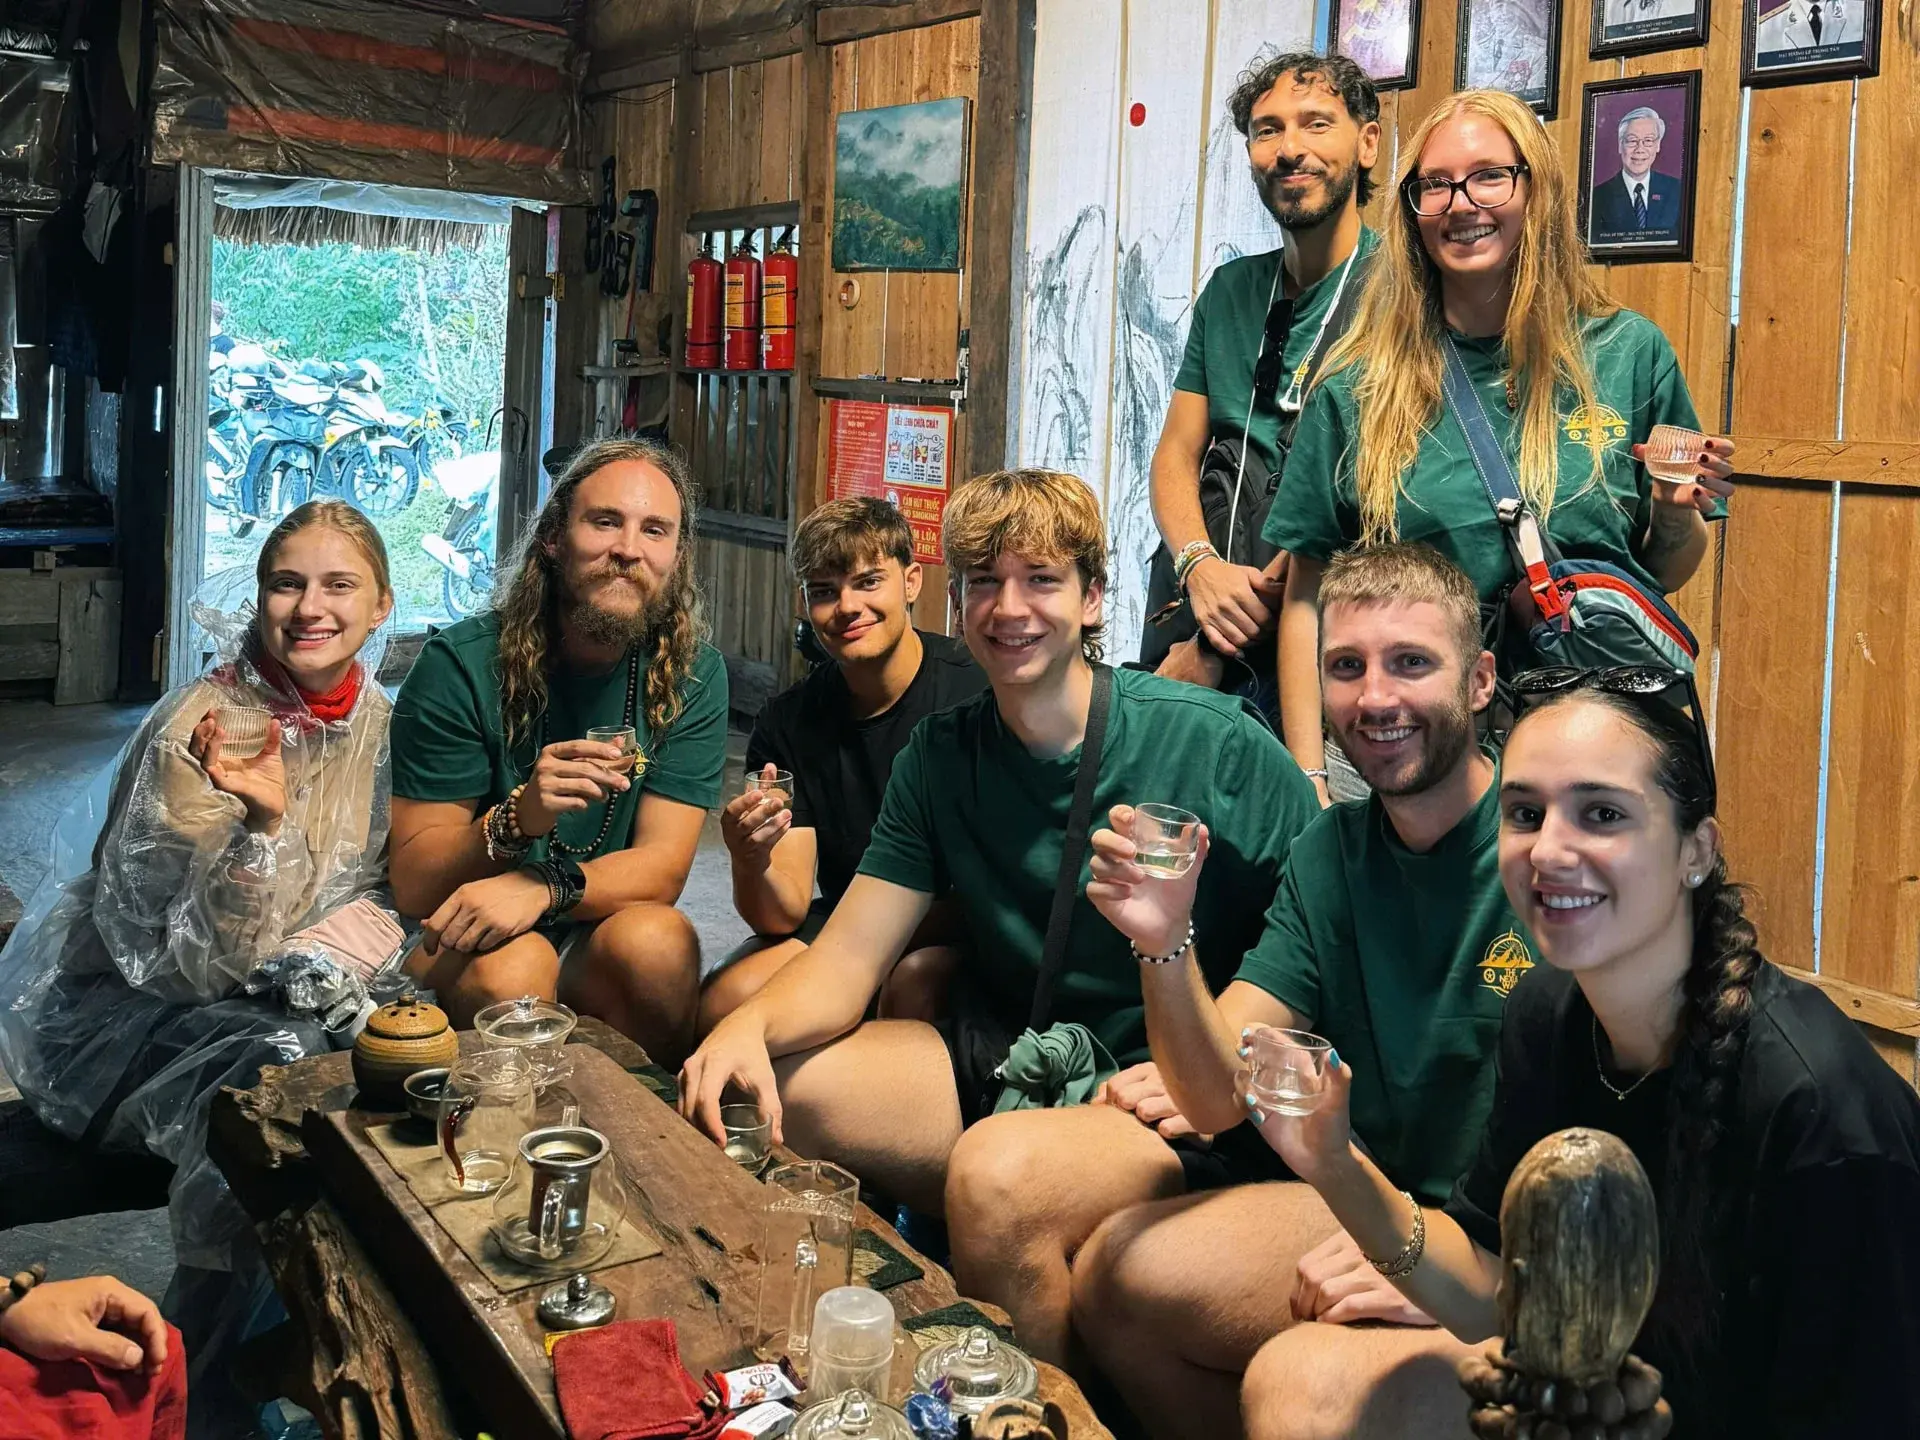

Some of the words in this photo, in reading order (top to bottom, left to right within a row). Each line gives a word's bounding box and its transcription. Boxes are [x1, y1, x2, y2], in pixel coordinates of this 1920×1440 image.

[912, 511, 939, 522] SMOKING
[921, 528, 937, 542] LỬA
[917, 543, 937, 555] FIRE
[1504, 968, 1516, 976] THE
[751, 1373, 773, 1385] VIP
